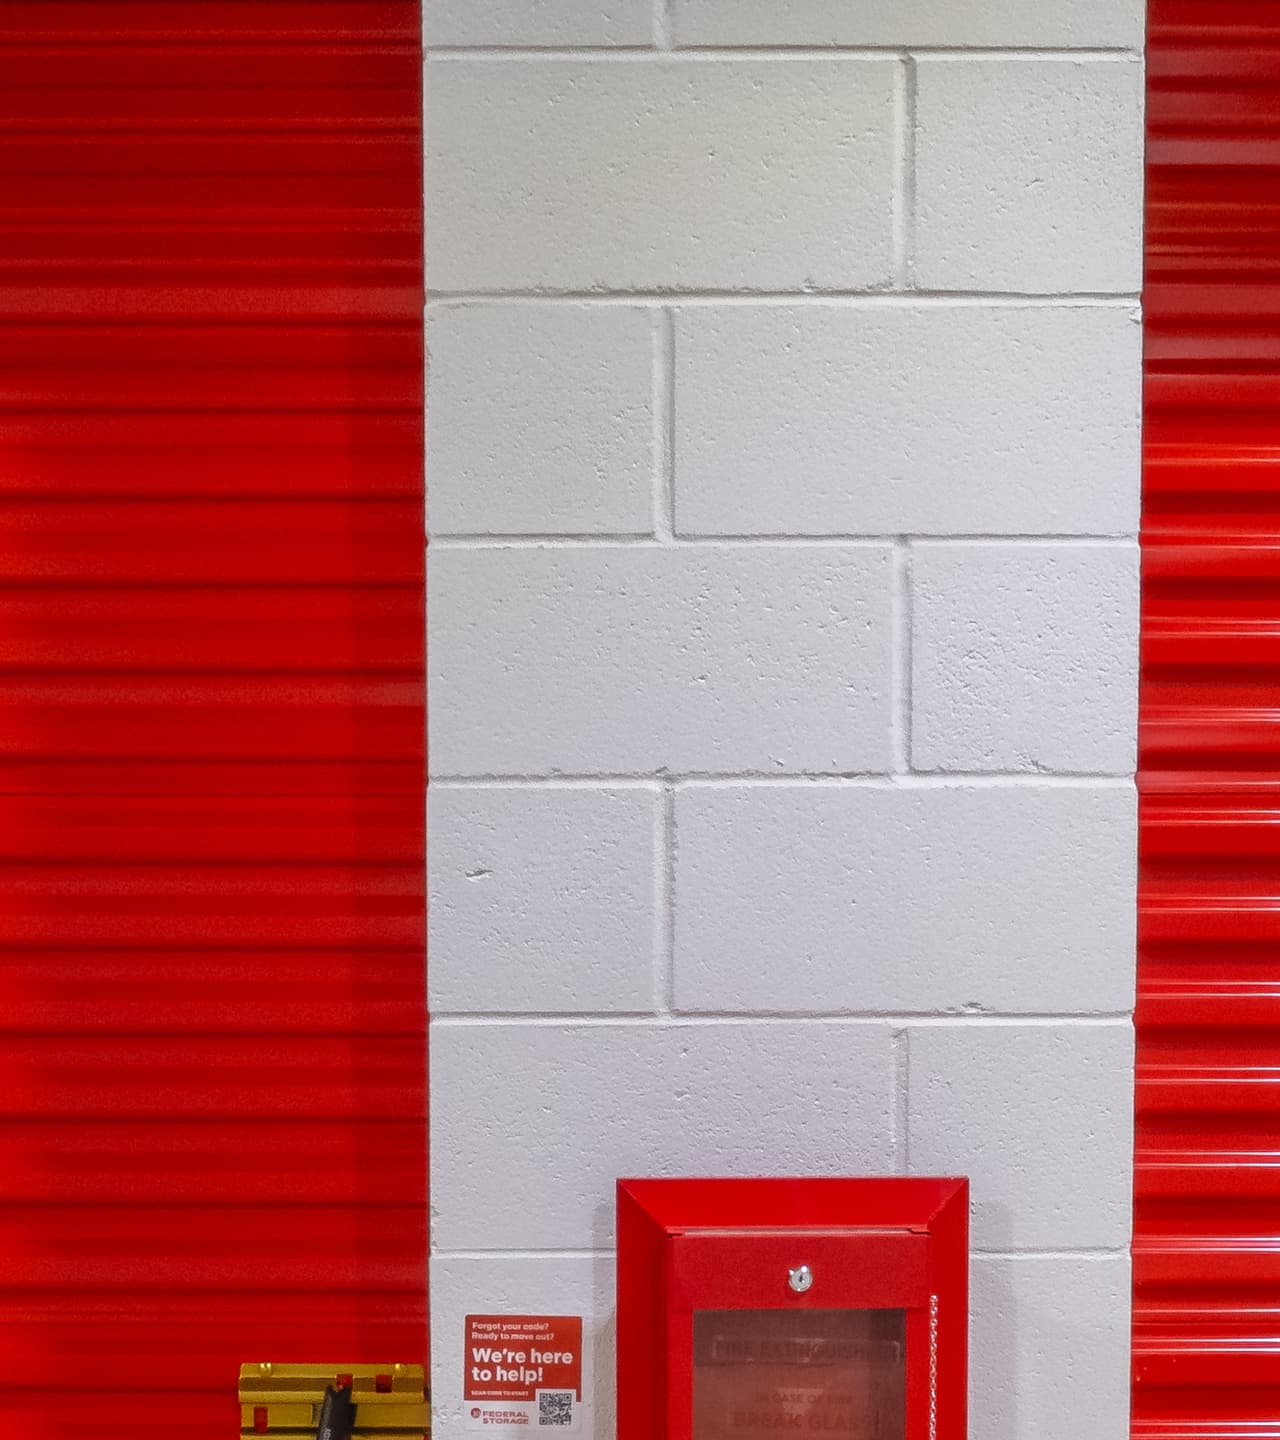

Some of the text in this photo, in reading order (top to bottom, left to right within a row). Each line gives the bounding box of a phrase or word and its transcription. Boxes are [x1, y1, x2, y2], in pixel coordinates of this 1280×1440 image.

[472, 1322, 501, 1332] Forgot
[503, 1323, 521, 1331] your
[472, 1332, 499, 1341] Ready
[536, 1333, 555, 1341] out?
[472, 1347, 574, 1364] We're here
[472, 1366, 543, 1385] to help!
[482, 1410, 529, 1418] FEDERAL
